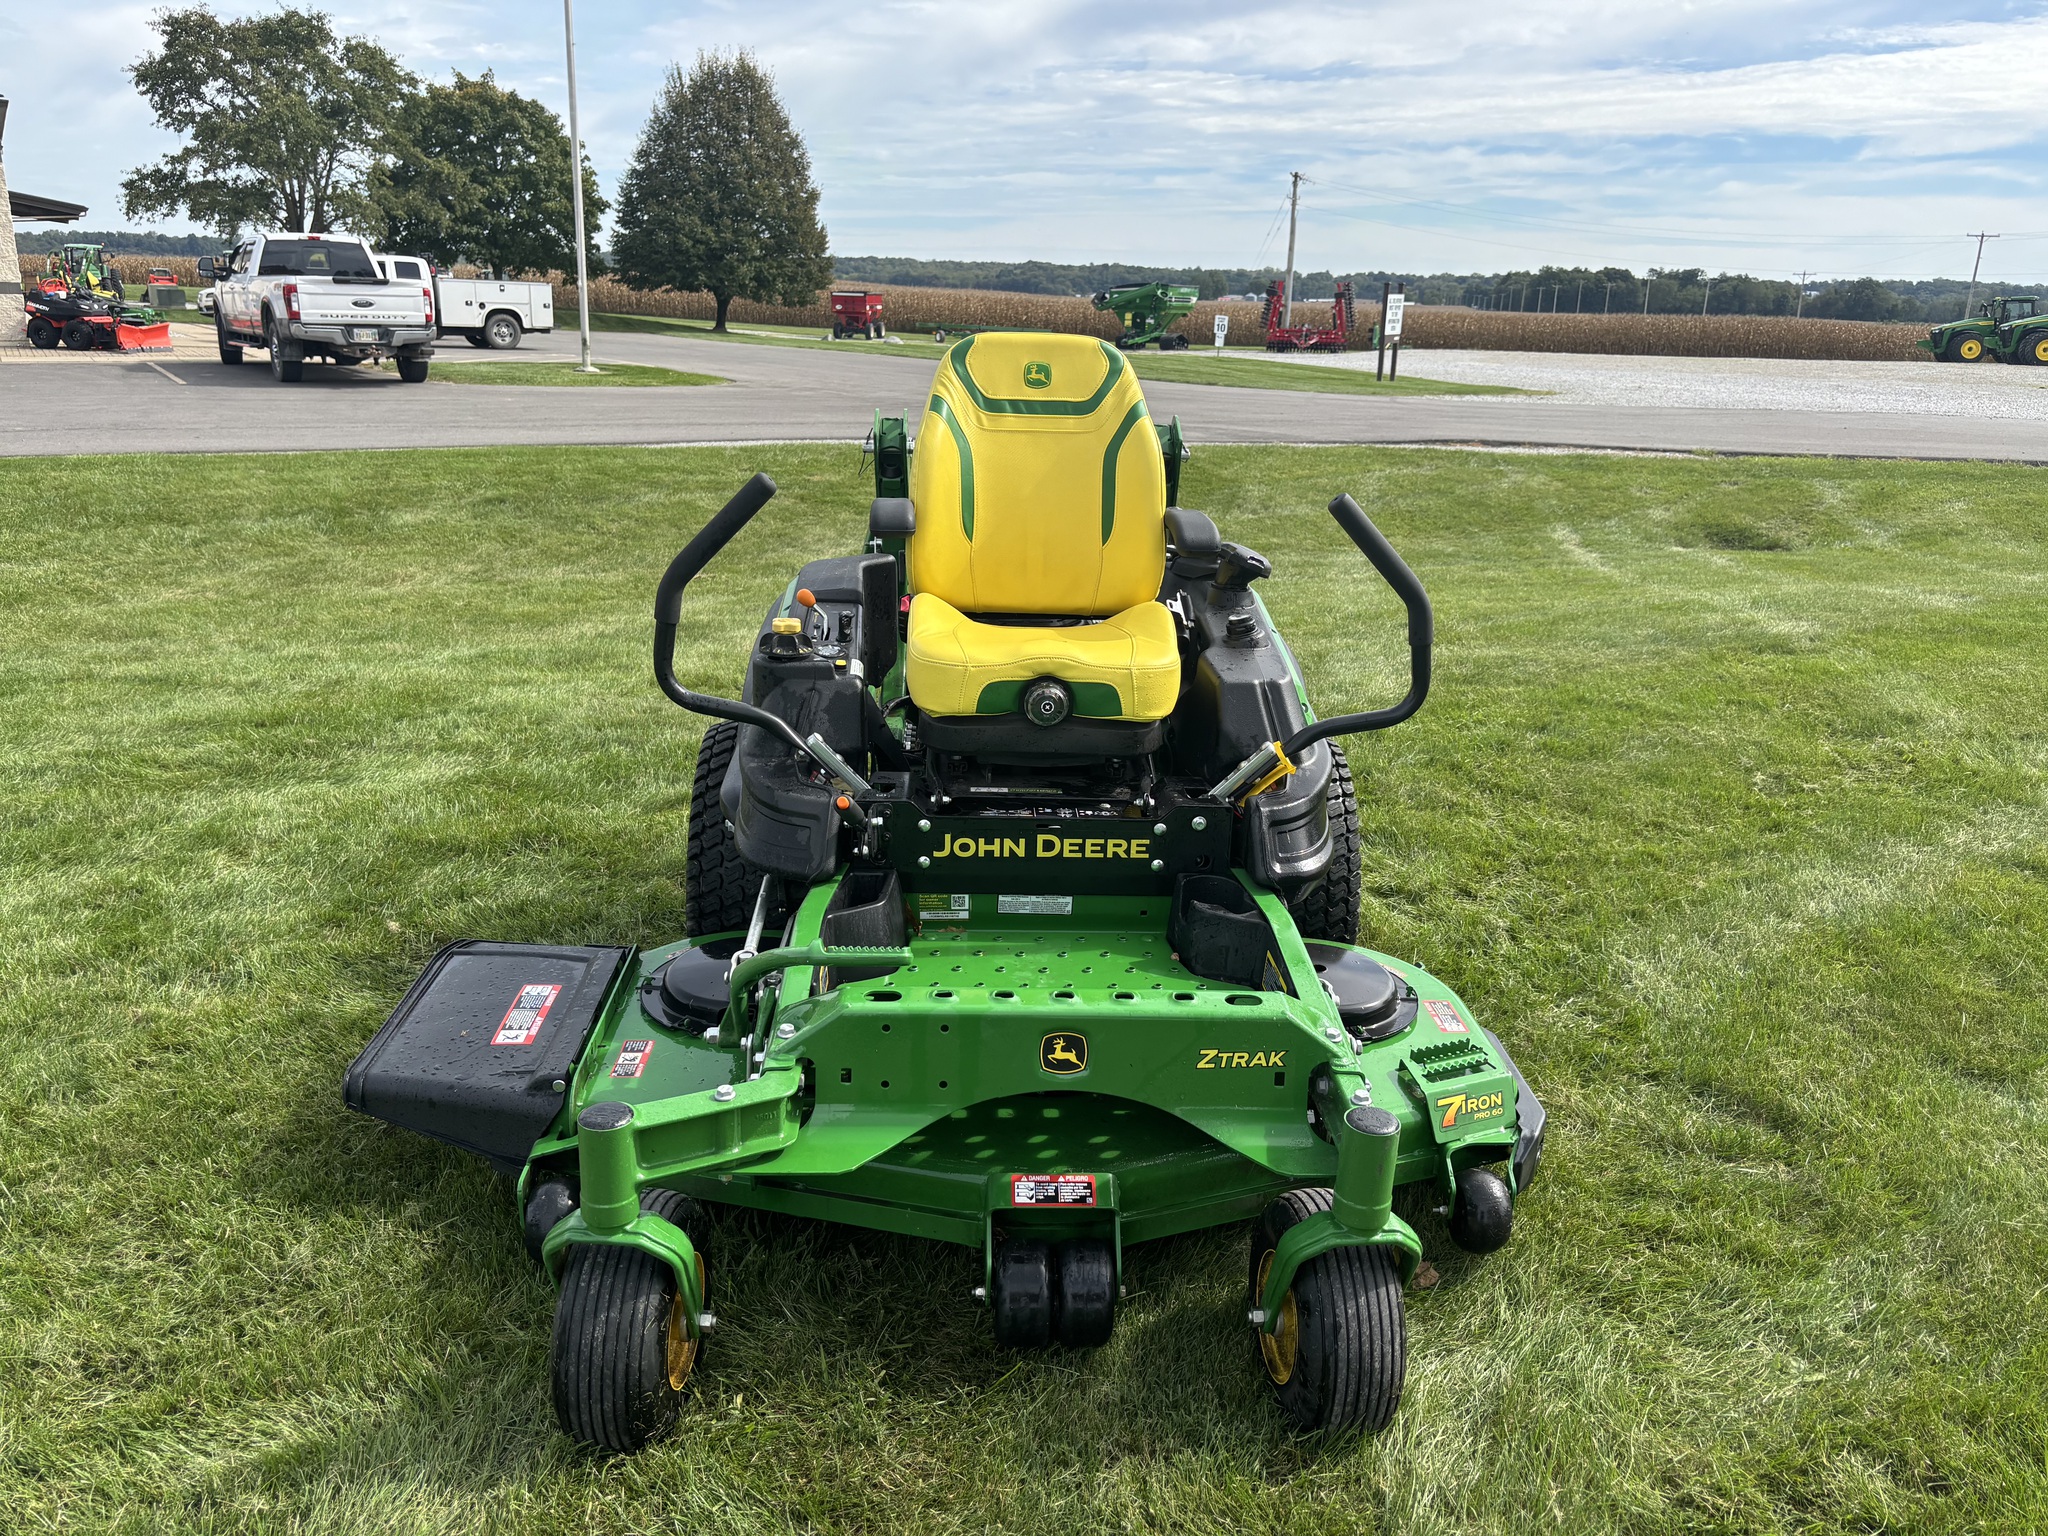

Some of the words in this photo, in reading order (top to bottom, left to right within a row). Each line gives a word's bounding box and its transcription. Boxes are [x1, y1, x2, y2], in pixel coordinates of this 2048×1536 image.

[1216, 323, 1226, 332] 10
[933, 833, 1026, 858] JOHN
[1036, 834, 1150, 859] DEERE
[1196, 1049, 1288, 1068] ZTRAK
[1437, 1093, 1466, 1128] 7
[1461, 1092, 1502, 1114] IRON
[1474, 1112, 1490, 1120] PRO
[1492, 1107, 1503, 1116] 60
